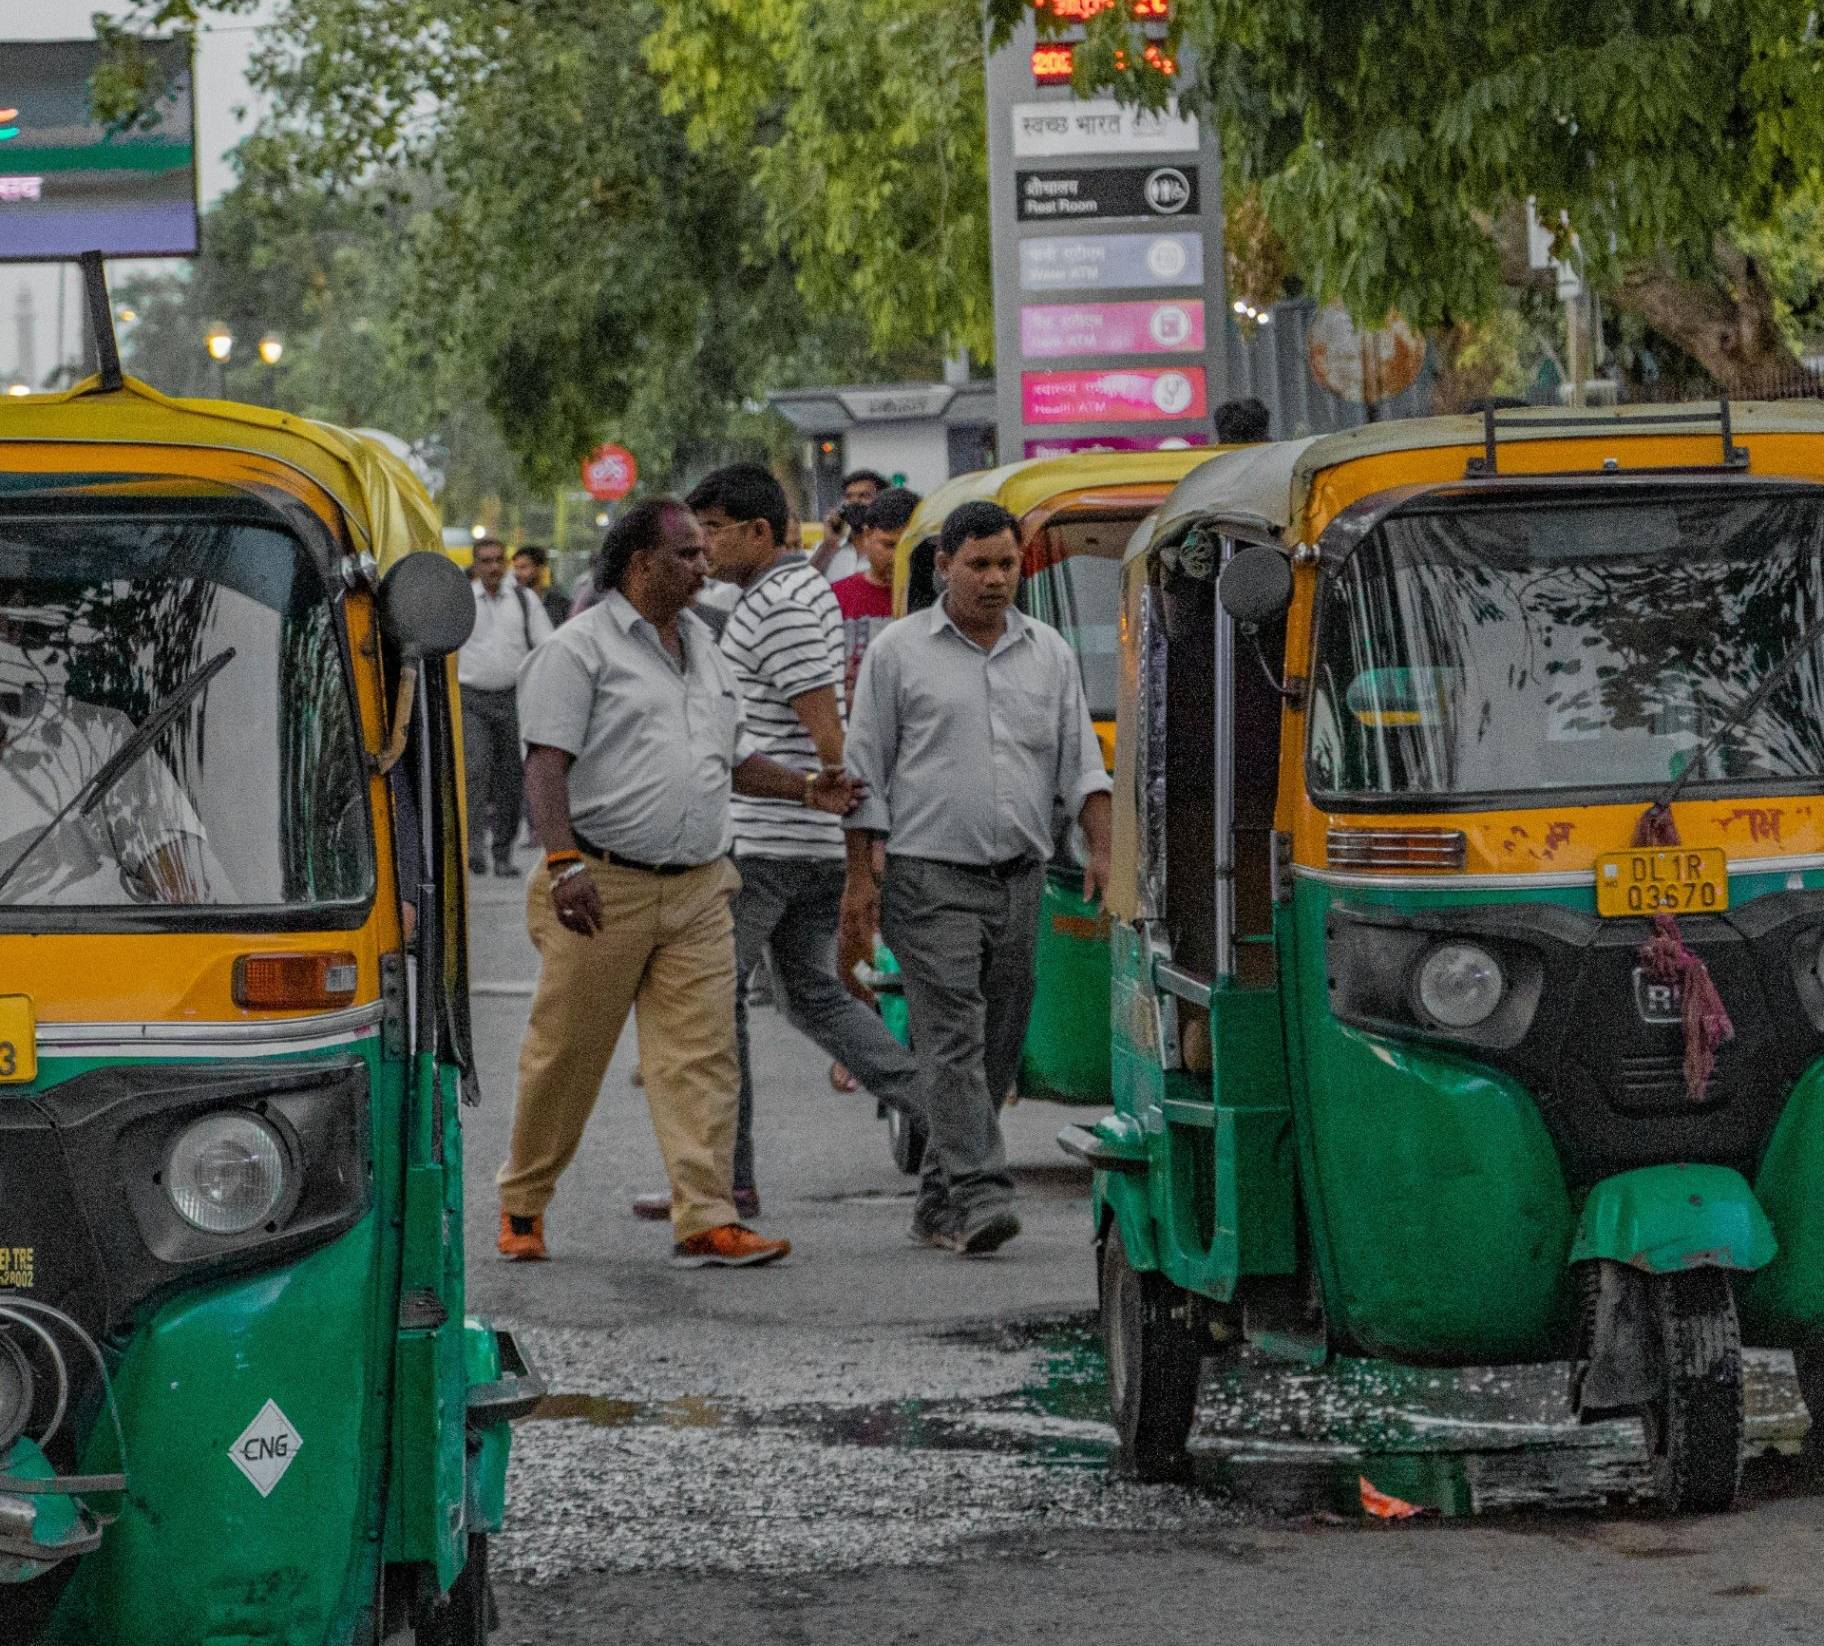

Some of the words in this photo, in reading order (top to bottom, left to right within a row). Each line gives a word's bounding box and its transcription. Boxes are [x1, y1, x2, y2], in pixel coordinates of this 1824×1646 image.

[1075, 114, 1121, 136] भारत
[1025, 198, 1057, 214] Rest
[1059, 197, 1098, 212] Room
[1078, 401, 1106, 414] ATM
[244, 1434, 288, 1460] CNG
